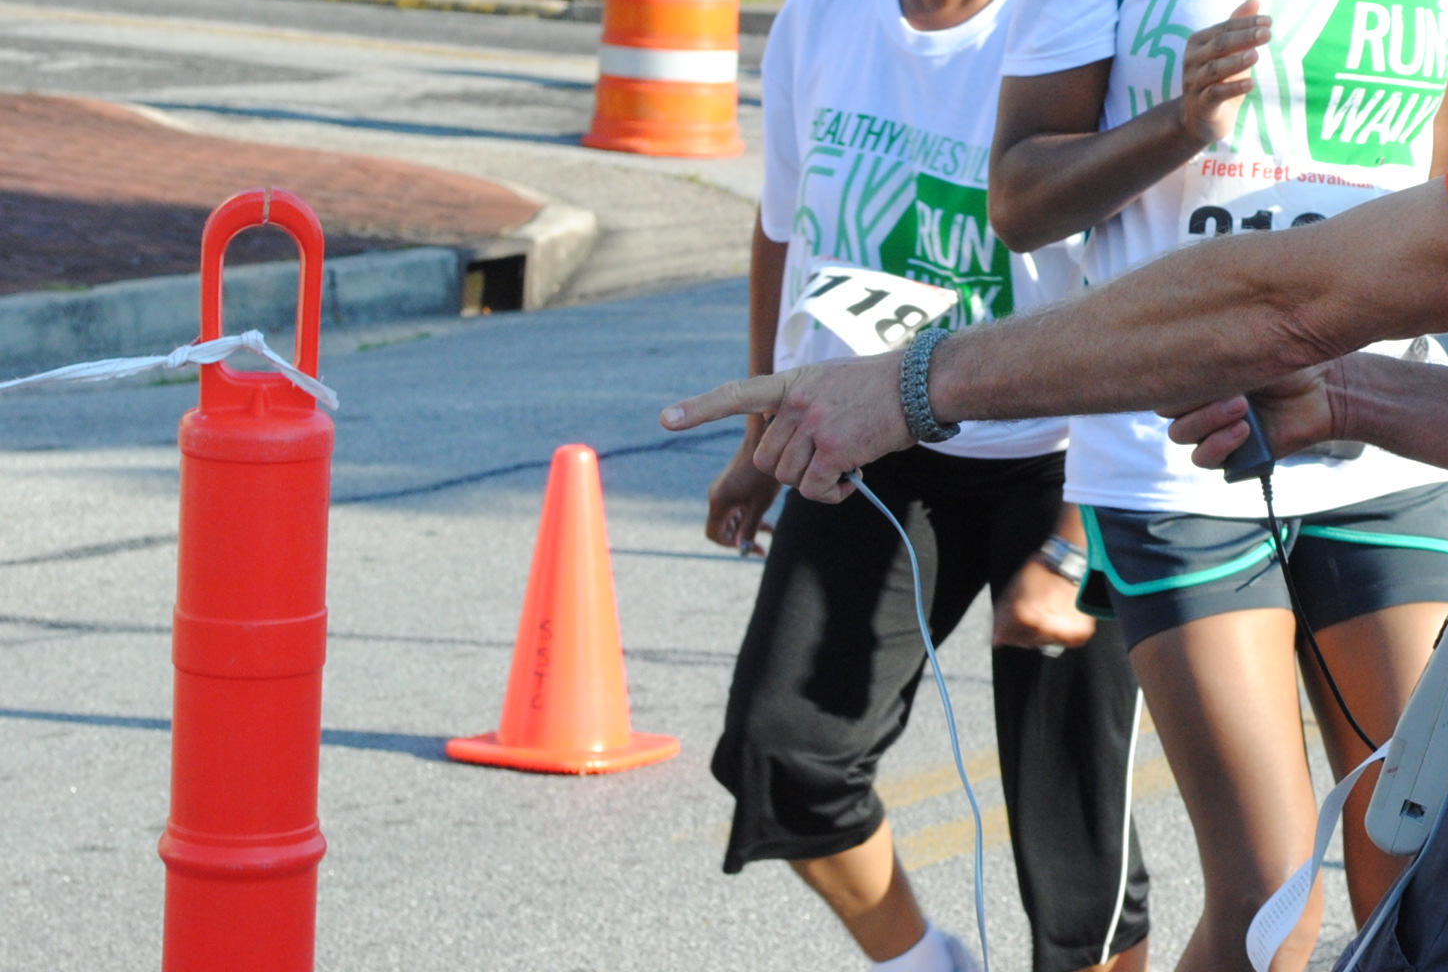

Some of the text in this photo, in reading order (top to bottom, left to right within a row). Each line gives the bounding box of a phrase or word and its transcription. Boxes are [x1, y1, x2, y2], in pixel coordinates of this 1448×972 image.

[1202, 159, 1245, 178] Fleet
[1252, 162, 1291, 182] Feet
[914, 200, 998, 275] RUN
